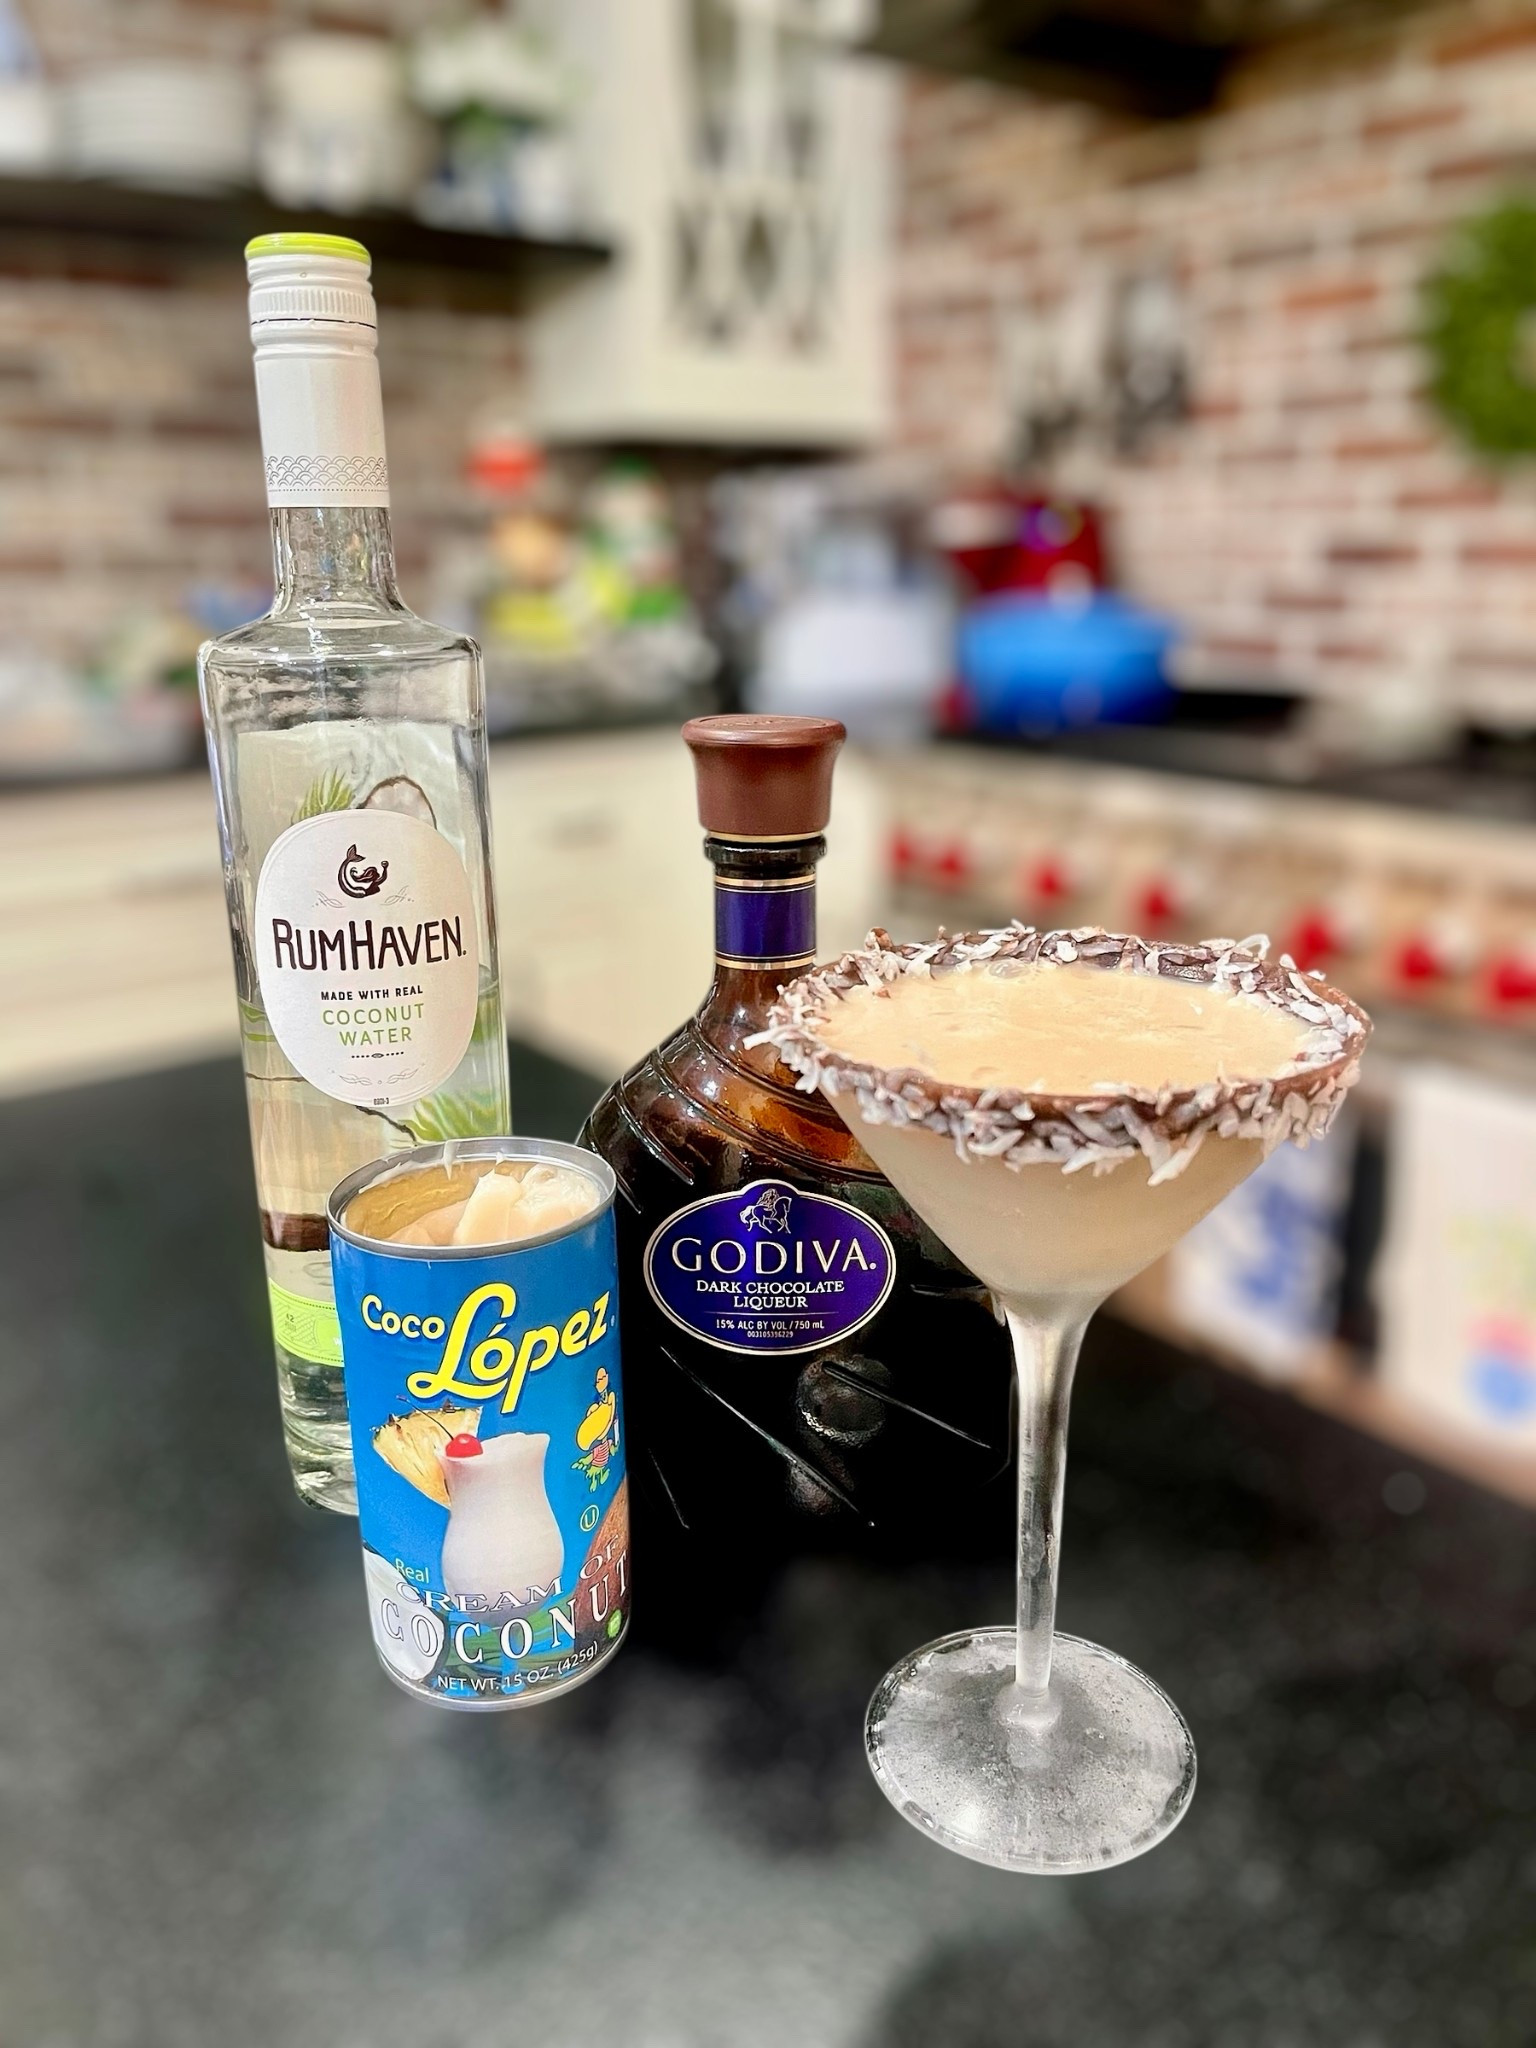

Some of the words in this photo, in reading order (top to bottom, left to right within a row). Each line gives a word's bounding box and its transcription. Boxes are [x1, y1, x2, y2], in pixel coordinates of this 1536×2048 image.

[320, 990, 353, 1001] MADE
[358, 988, 390, 1000] WITH
[395, 984, 424, 997] REAL
[323, 1003, 425, 1025] COCONUT
[340, 1026, 412, 1047] WATER
[696, 1280, 742, 1293] DARK
[746, 1280, 845, 1294] CHOCOLATE
[733, 1296, 809, 1310] LIQUEUR
[361, 1293, 446, 1340] Coco
[716, 1319, 735, 1329] 15%
[737, 1320, 754, 1330] ALC
[756, 1320, 768, 1330] BY
[771, 1321, 787, 1330] VOL
[812, 1320, 825, 1329] mL
[395, 1557, 430, 1584] Real
[395, 1575, 564, 1614] CREAM
[579, 1534, 620, 1580] OF
[380, 1550, 628, 1664] COCONUT
[437, 1674, 467, 1690] NET
[470, 1677, 500, 1691] WT.
[504, 1675, 523, 1688] 15
[526, 1663, 555, 1685] OZ.
[557, 1641, 599, 1676] (425g)
